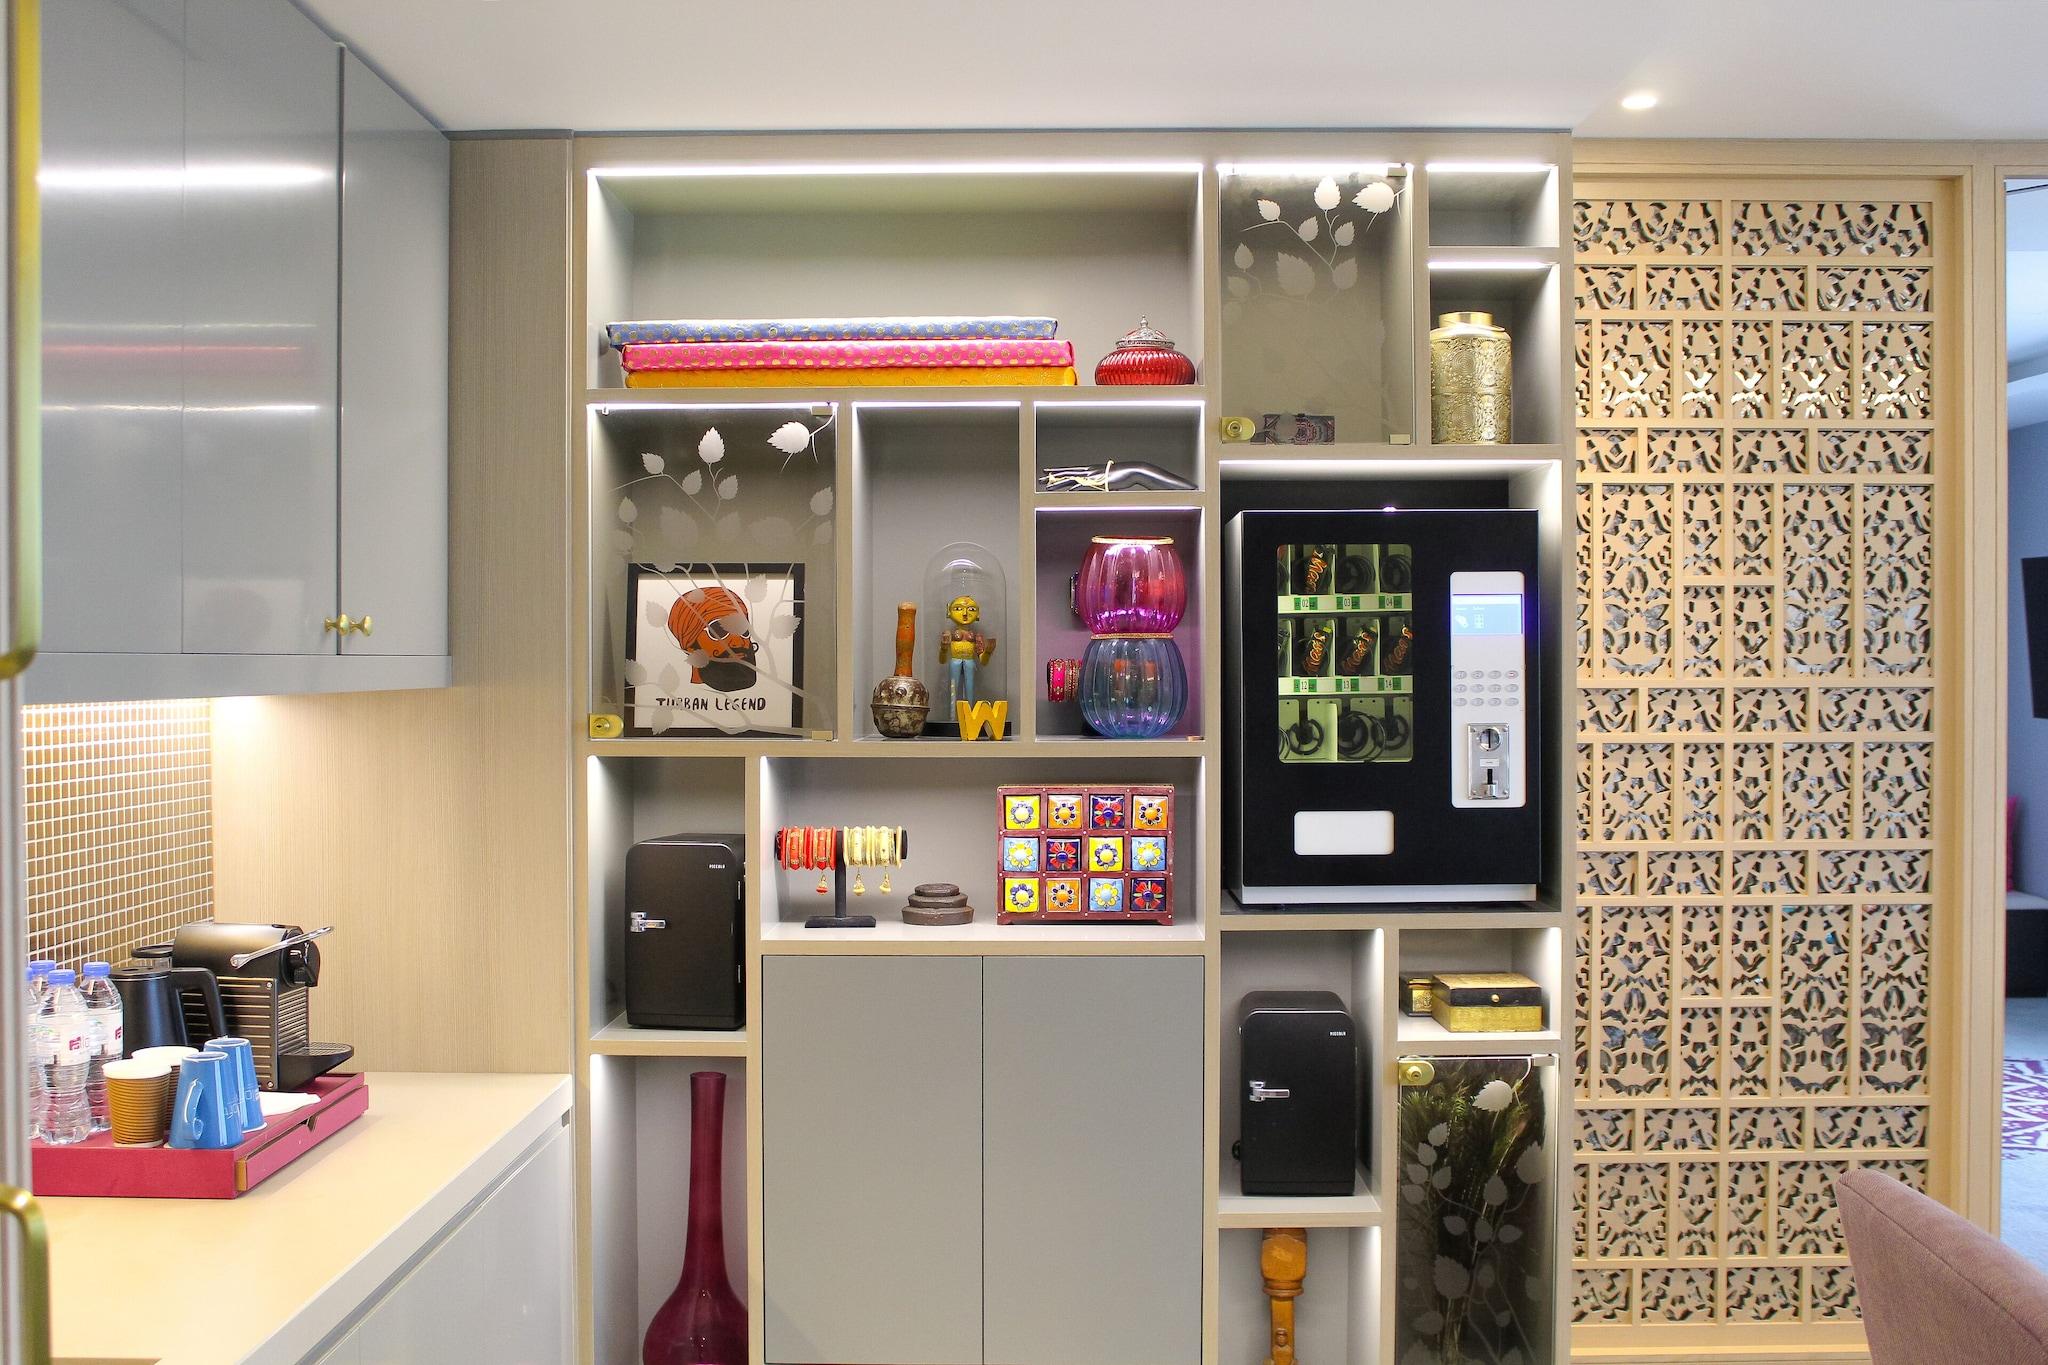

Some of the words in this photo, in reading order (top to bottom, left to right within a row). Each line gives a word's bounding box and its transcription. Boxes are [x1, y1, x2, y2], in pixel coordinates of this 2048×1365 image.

[1301, 598, 1309, 608] 02
[1343, 598, 1351, 607] 03
[1301, 680, 1308, 691] 12
[1343, 680, 1350, 690] 13
[1385, 679, 1393, 689] 14
[715, 697, 767, 711] LEGEND
